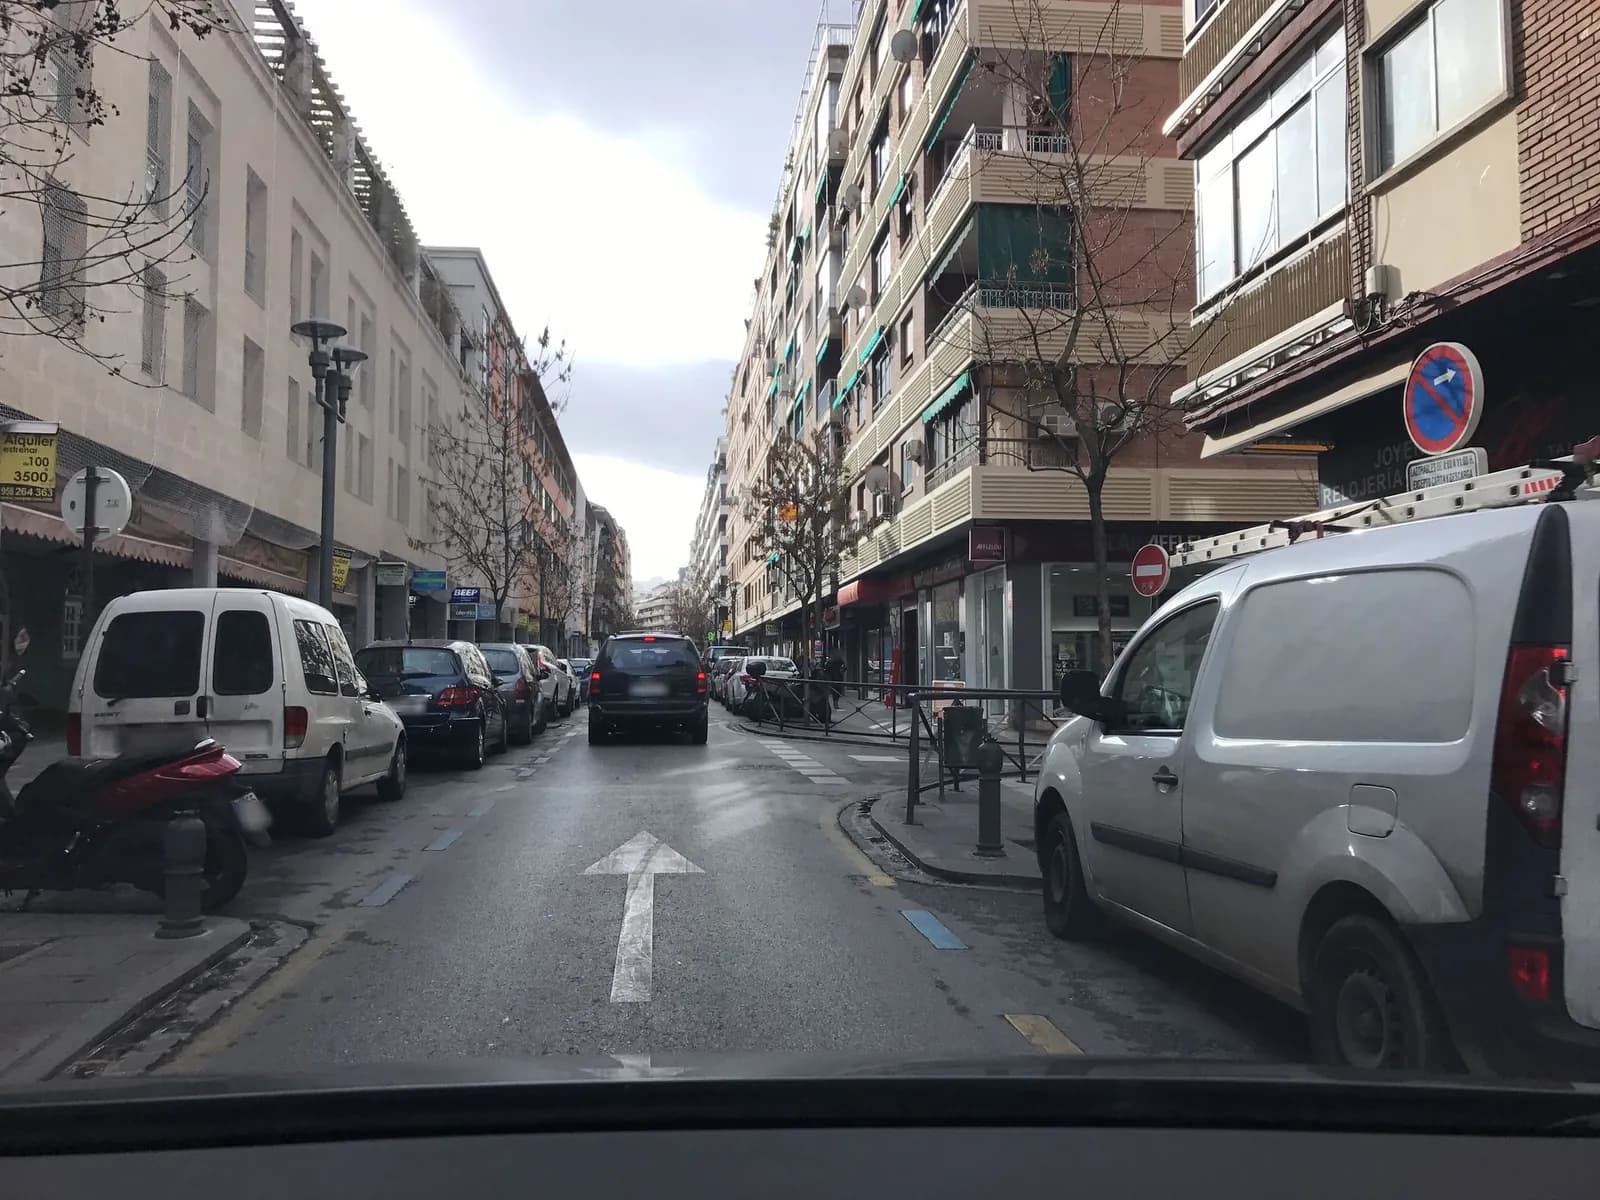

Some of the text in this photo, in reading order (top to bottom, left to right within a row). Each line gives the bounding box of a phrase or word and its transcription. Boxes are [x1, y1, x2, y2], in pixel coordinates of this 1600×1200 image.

[4, 434, 54, 447] Alquiler
[29, 456, 50, 468] 100
[14, 470, 48, 482] 3500
[15, 487, 33, 496] 264
[35, 487, 53, 497] 363
[454, 588, 479, 597] BEEP
